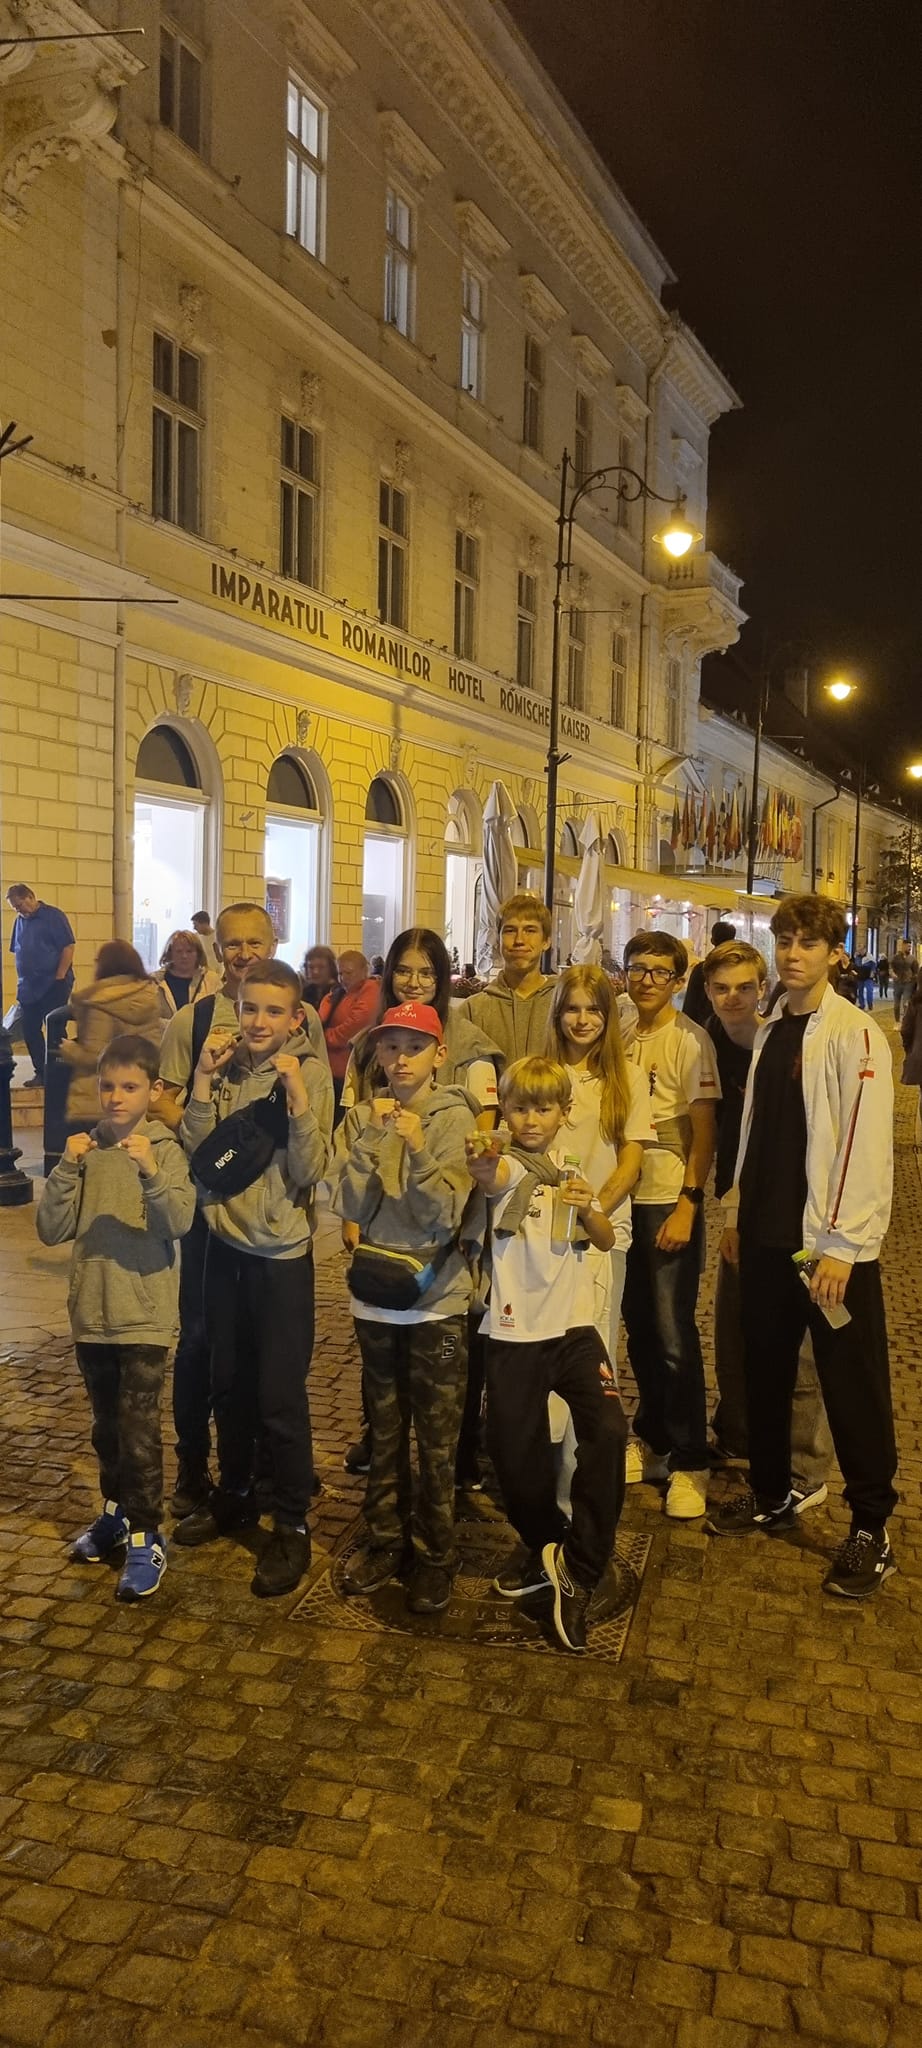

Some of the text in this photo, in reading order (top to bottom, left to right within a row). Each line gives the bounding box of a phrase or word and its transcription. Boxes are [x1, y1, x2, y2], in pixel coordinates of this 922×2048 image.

[211, 562, 329, 640] IMPARATUL
[342, 619, 431, 681] ROMANILOR
[448, 667, 485, 702] HOTEL
[561, 713, 590, 744] KAISER
[215, 1149, 237, 1169] NASA
